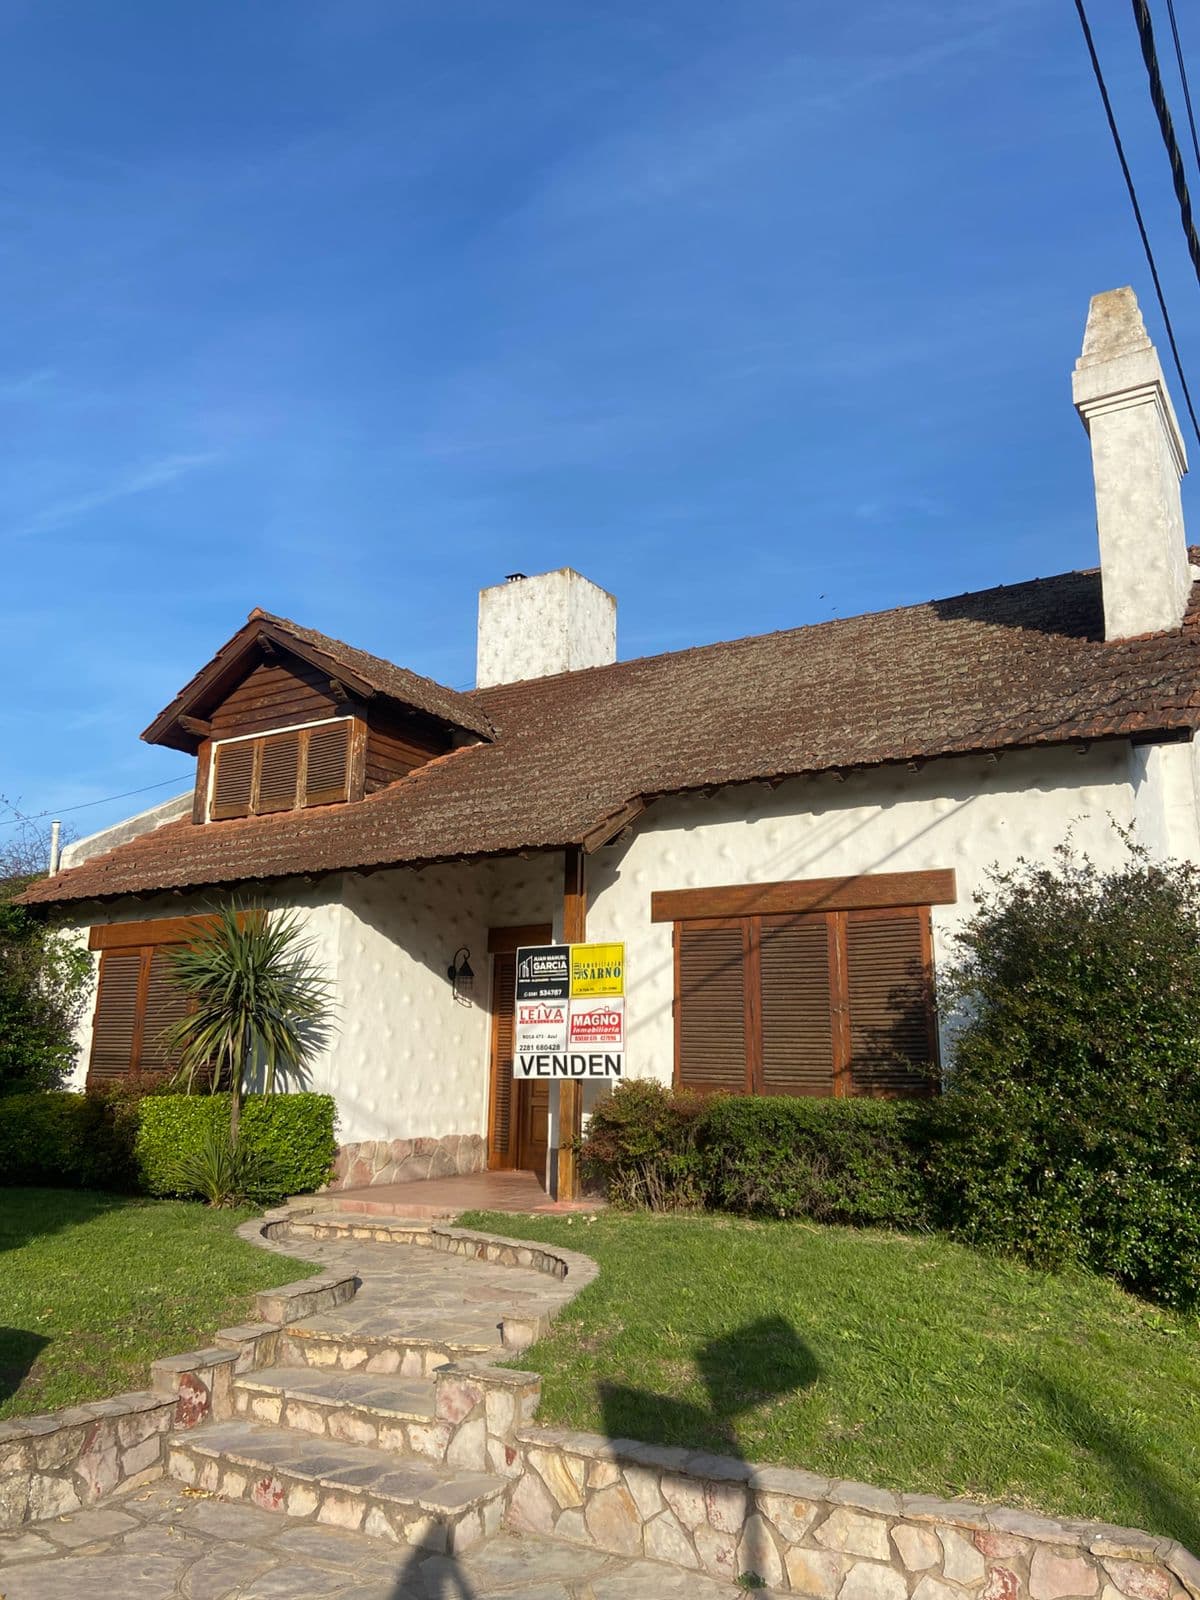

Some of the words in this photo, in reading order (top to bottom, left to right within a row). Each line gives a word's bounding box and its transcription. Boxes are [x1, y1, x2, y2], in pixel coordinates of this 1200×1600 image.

[533, 961, 567, 970] GARCIA
[583, 967, 621, 980] SARNO
[520, 1008, 563, 1020] LEIVA
[573, 1014, 619, 1026] MAGNO
[520, 1054, 621, 1076] VENDEN
